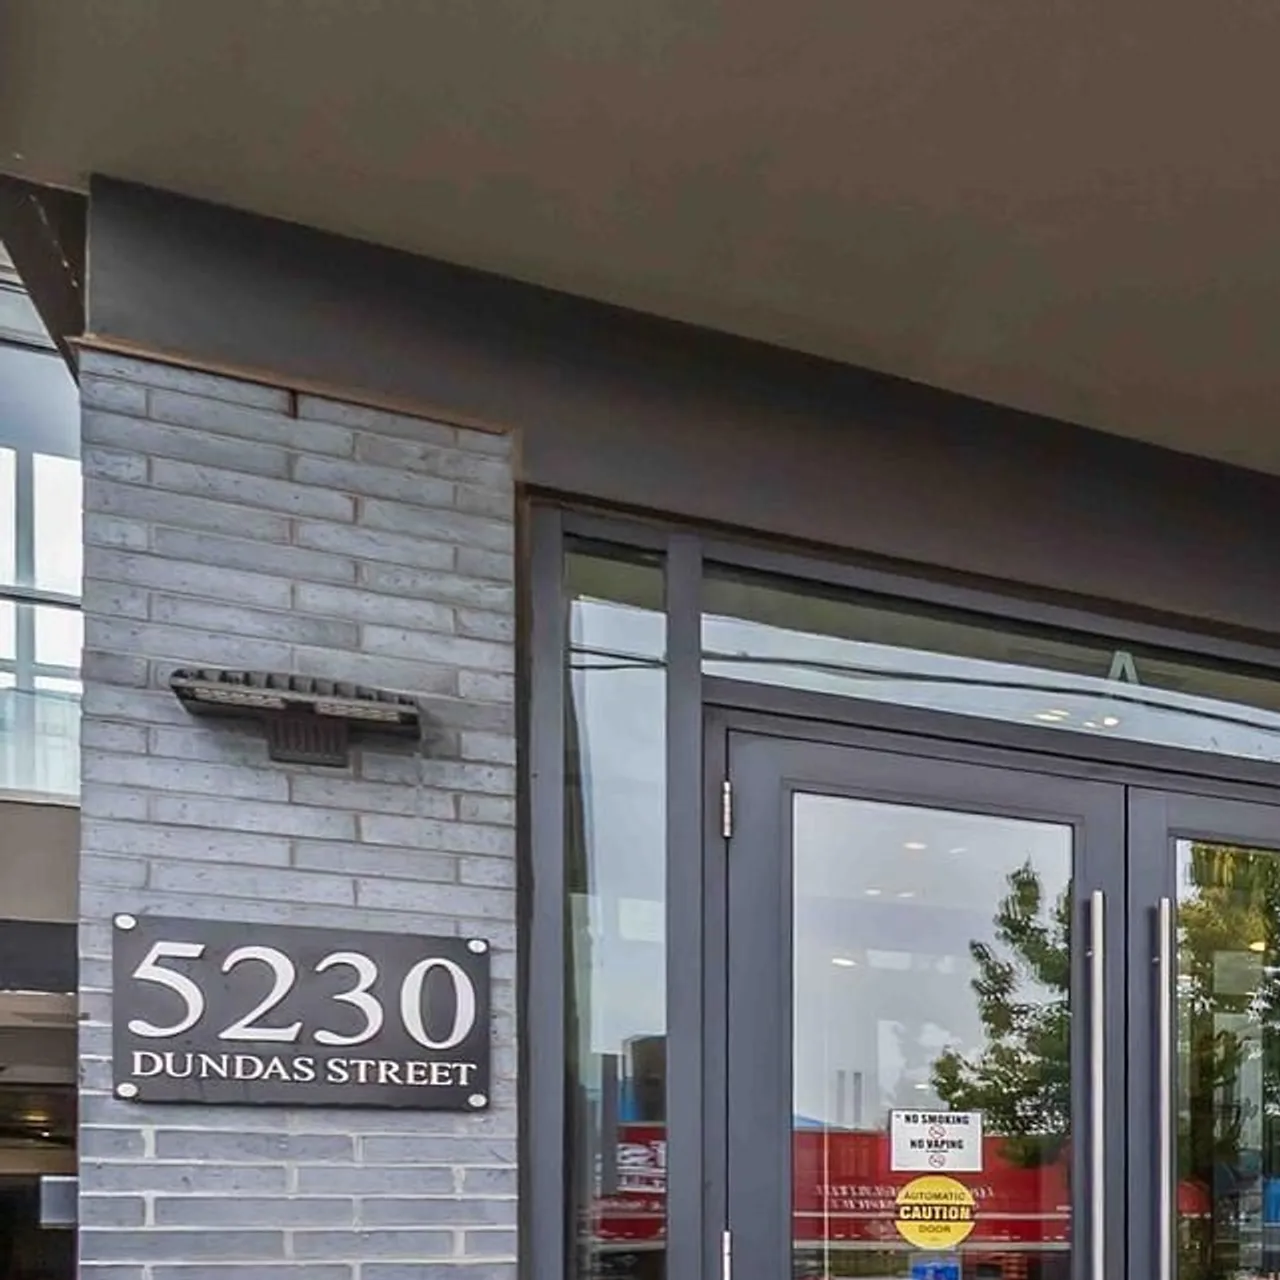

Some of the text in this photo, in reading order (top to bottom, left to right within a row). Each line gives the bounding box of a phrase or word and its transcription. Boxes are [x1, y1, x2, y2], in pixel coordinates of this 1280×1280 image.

[128, 941, 476, 1050] 5230
[131, 1051, 478, 1087] DUNDAS STREET
[904, 1114, 970, 1125] NO SMOKING
[910, 1139, 964, 1150] NO VAPING
[904, 1191, 966, 1201] AUTOMATIC
[900, 1205, 970, 1220] CAUTION
[919, 1224, 951, 1234] DOOR
